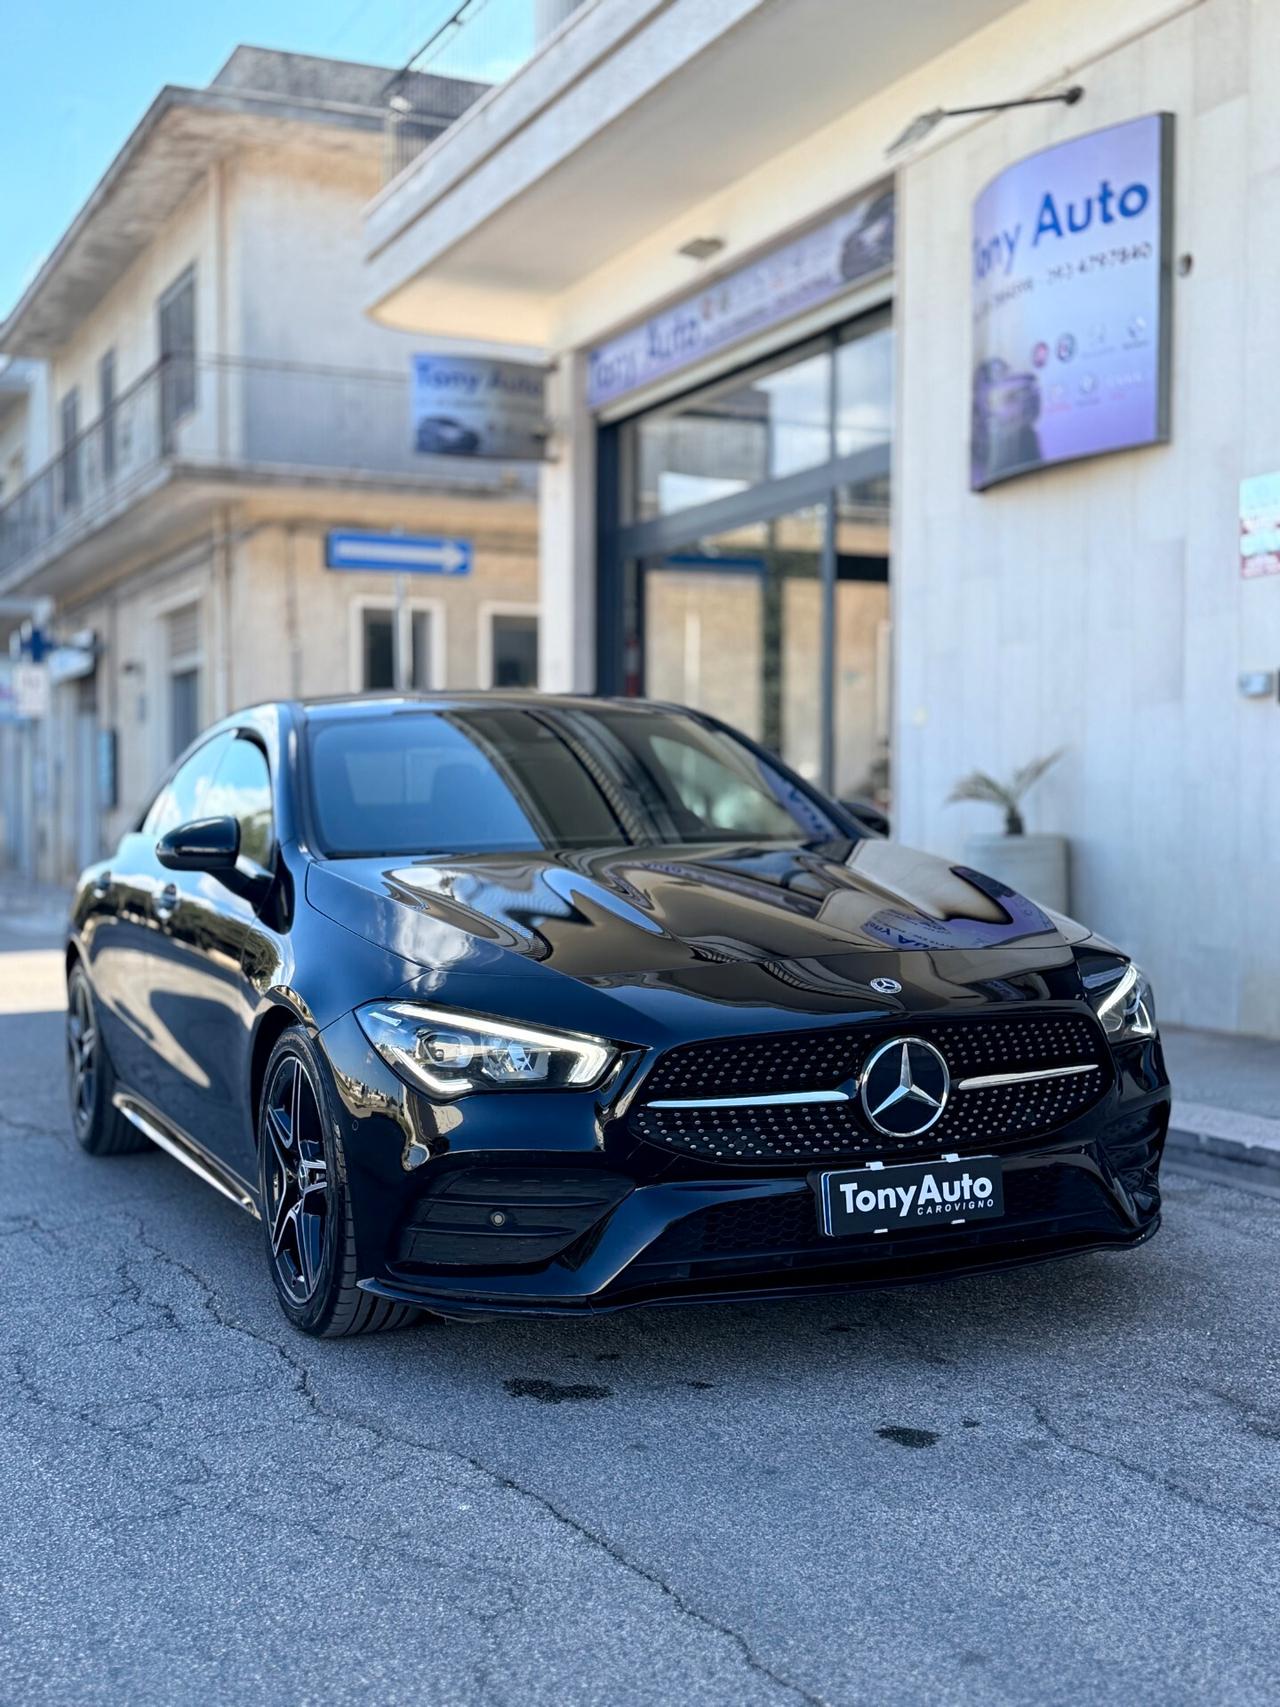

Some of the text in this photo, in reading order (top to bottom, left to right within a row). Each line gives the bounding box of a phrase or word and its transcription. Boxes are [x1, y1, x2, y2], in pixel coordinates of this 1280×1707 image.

[1032, 179, 1150, 247] Auto
[646, 316, 698, 359] Auto
[839, 1173, 993, 1217] TonyAuto
[917, 1198, 994, 1216] CAROVIGNO
